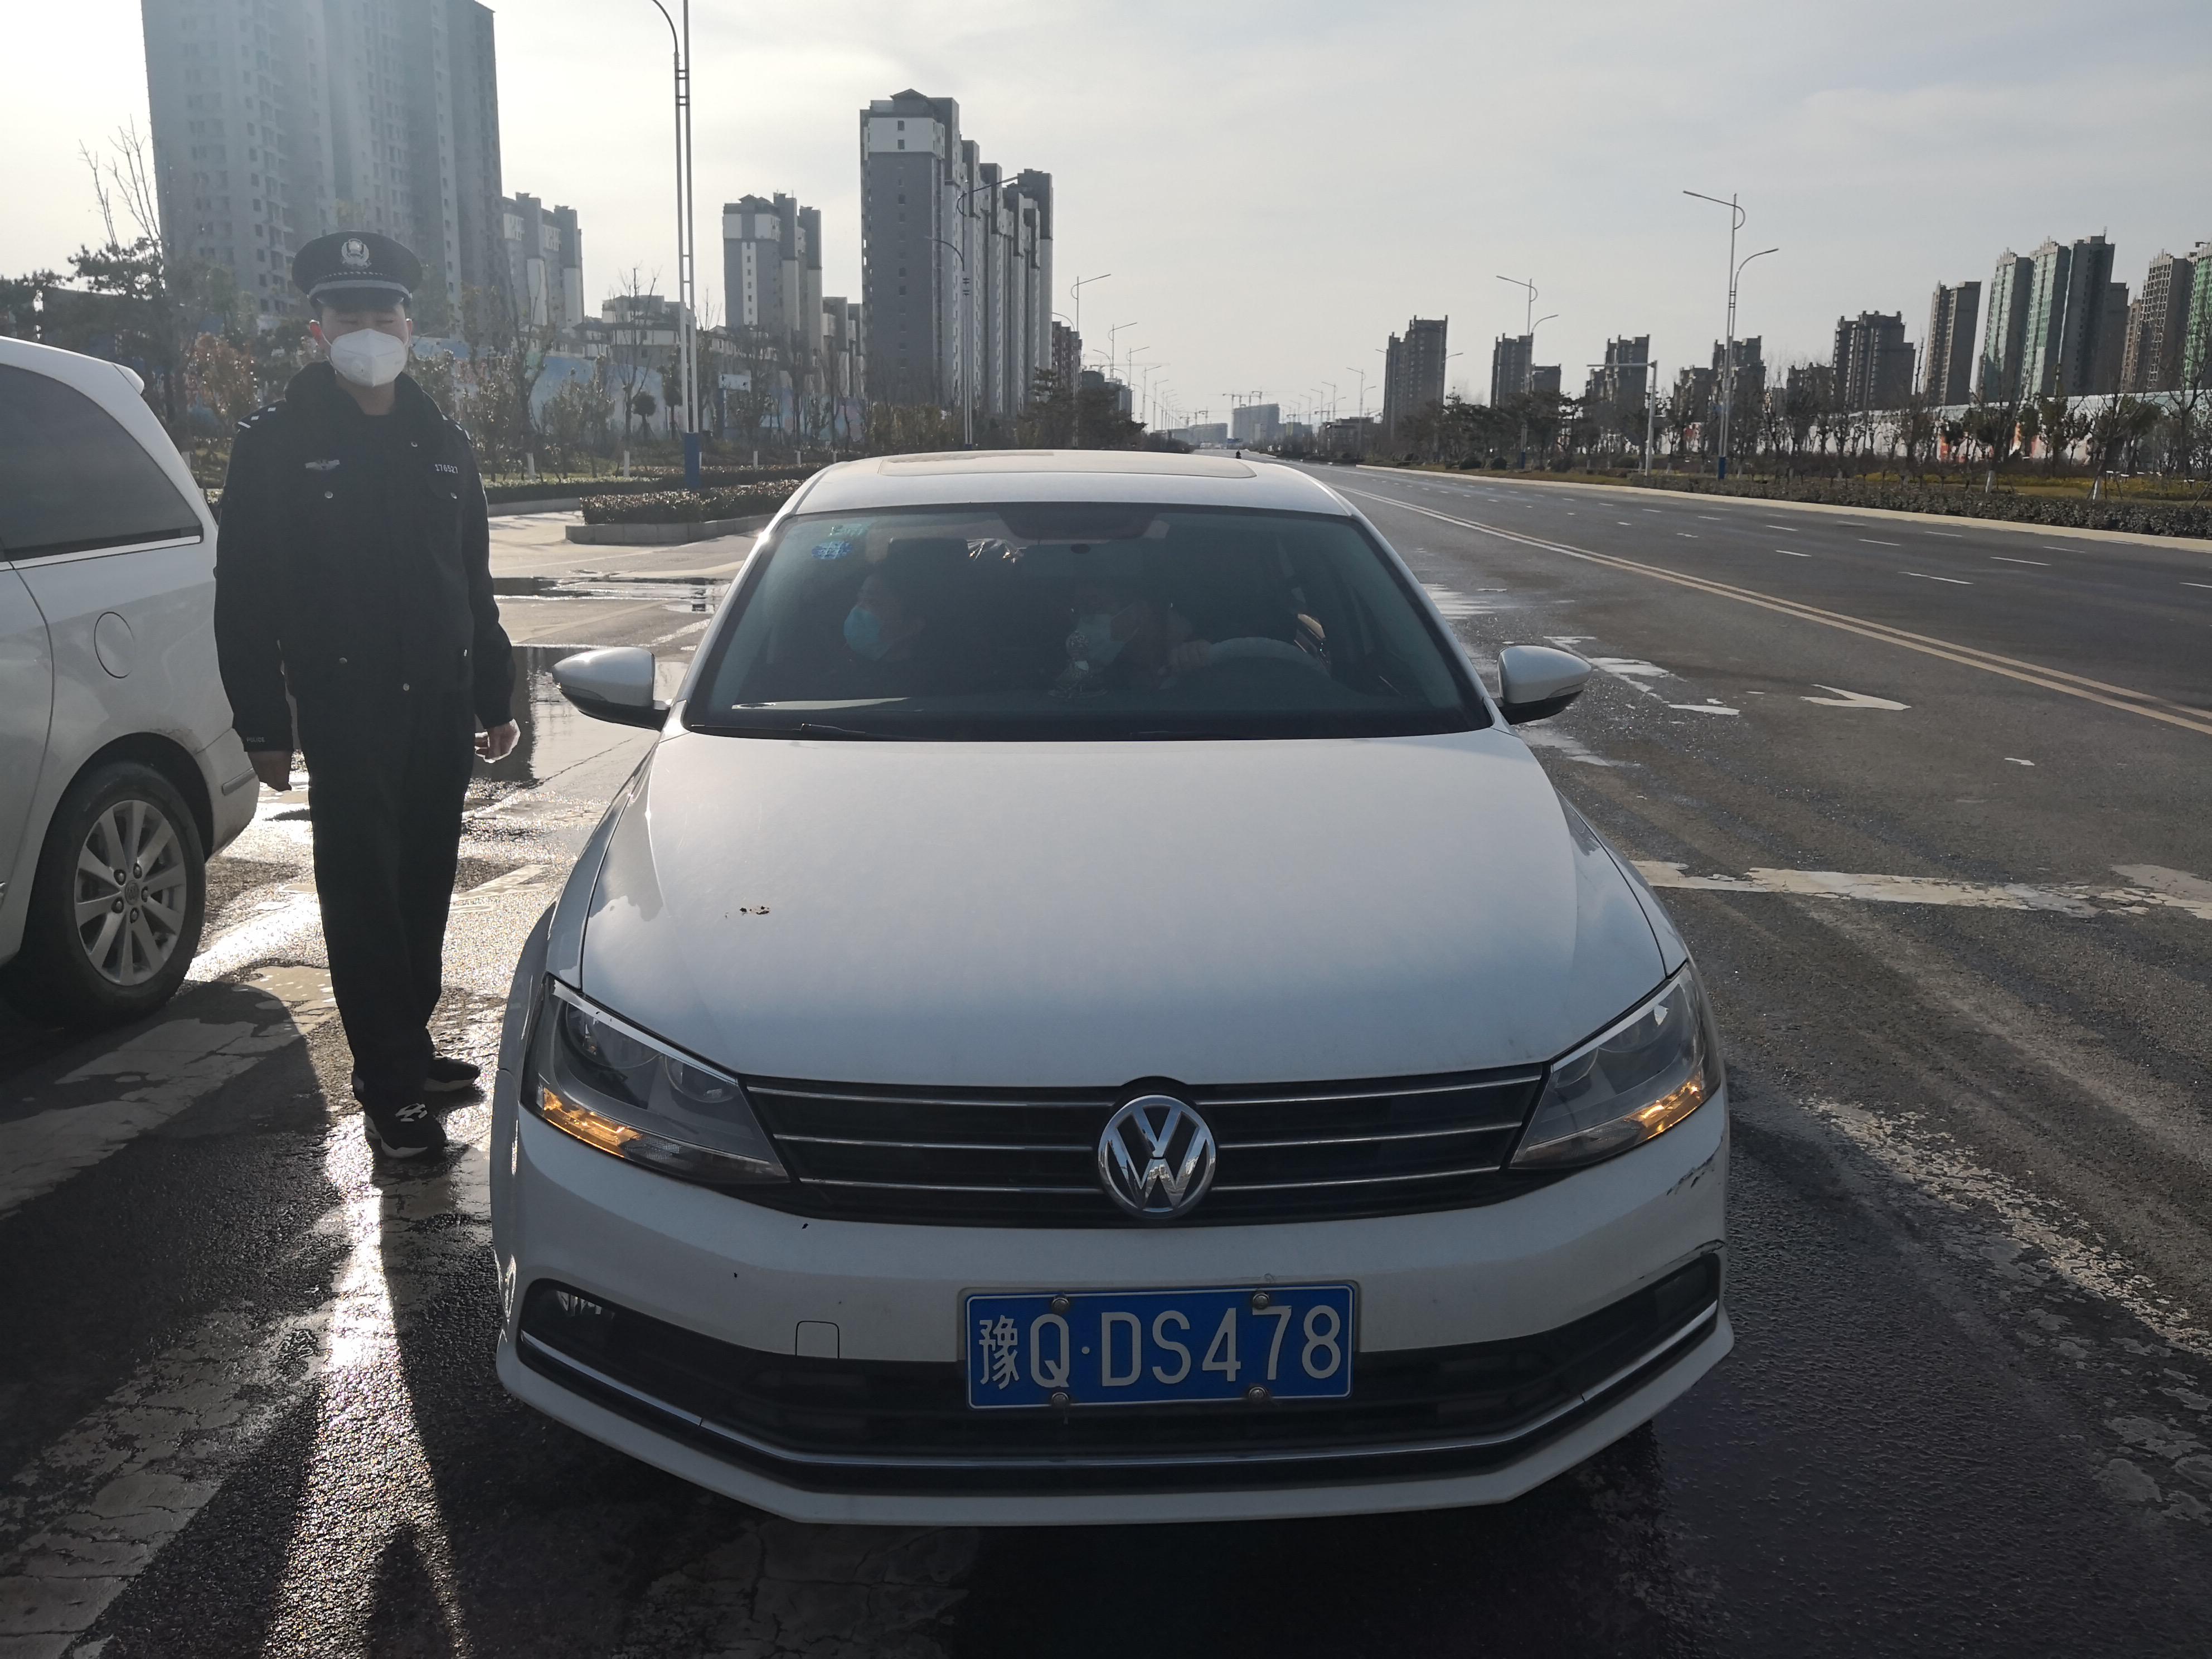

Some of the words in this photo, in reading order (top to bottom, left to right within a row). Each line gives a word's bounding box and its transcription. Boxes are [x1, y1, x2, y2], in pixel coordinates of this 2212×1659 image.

[435, 464, 458, 473] 176527
[1098, 1095, 1216, 1219] VW
[978, 1304, 1341, 1390] 豫Q·DS478
